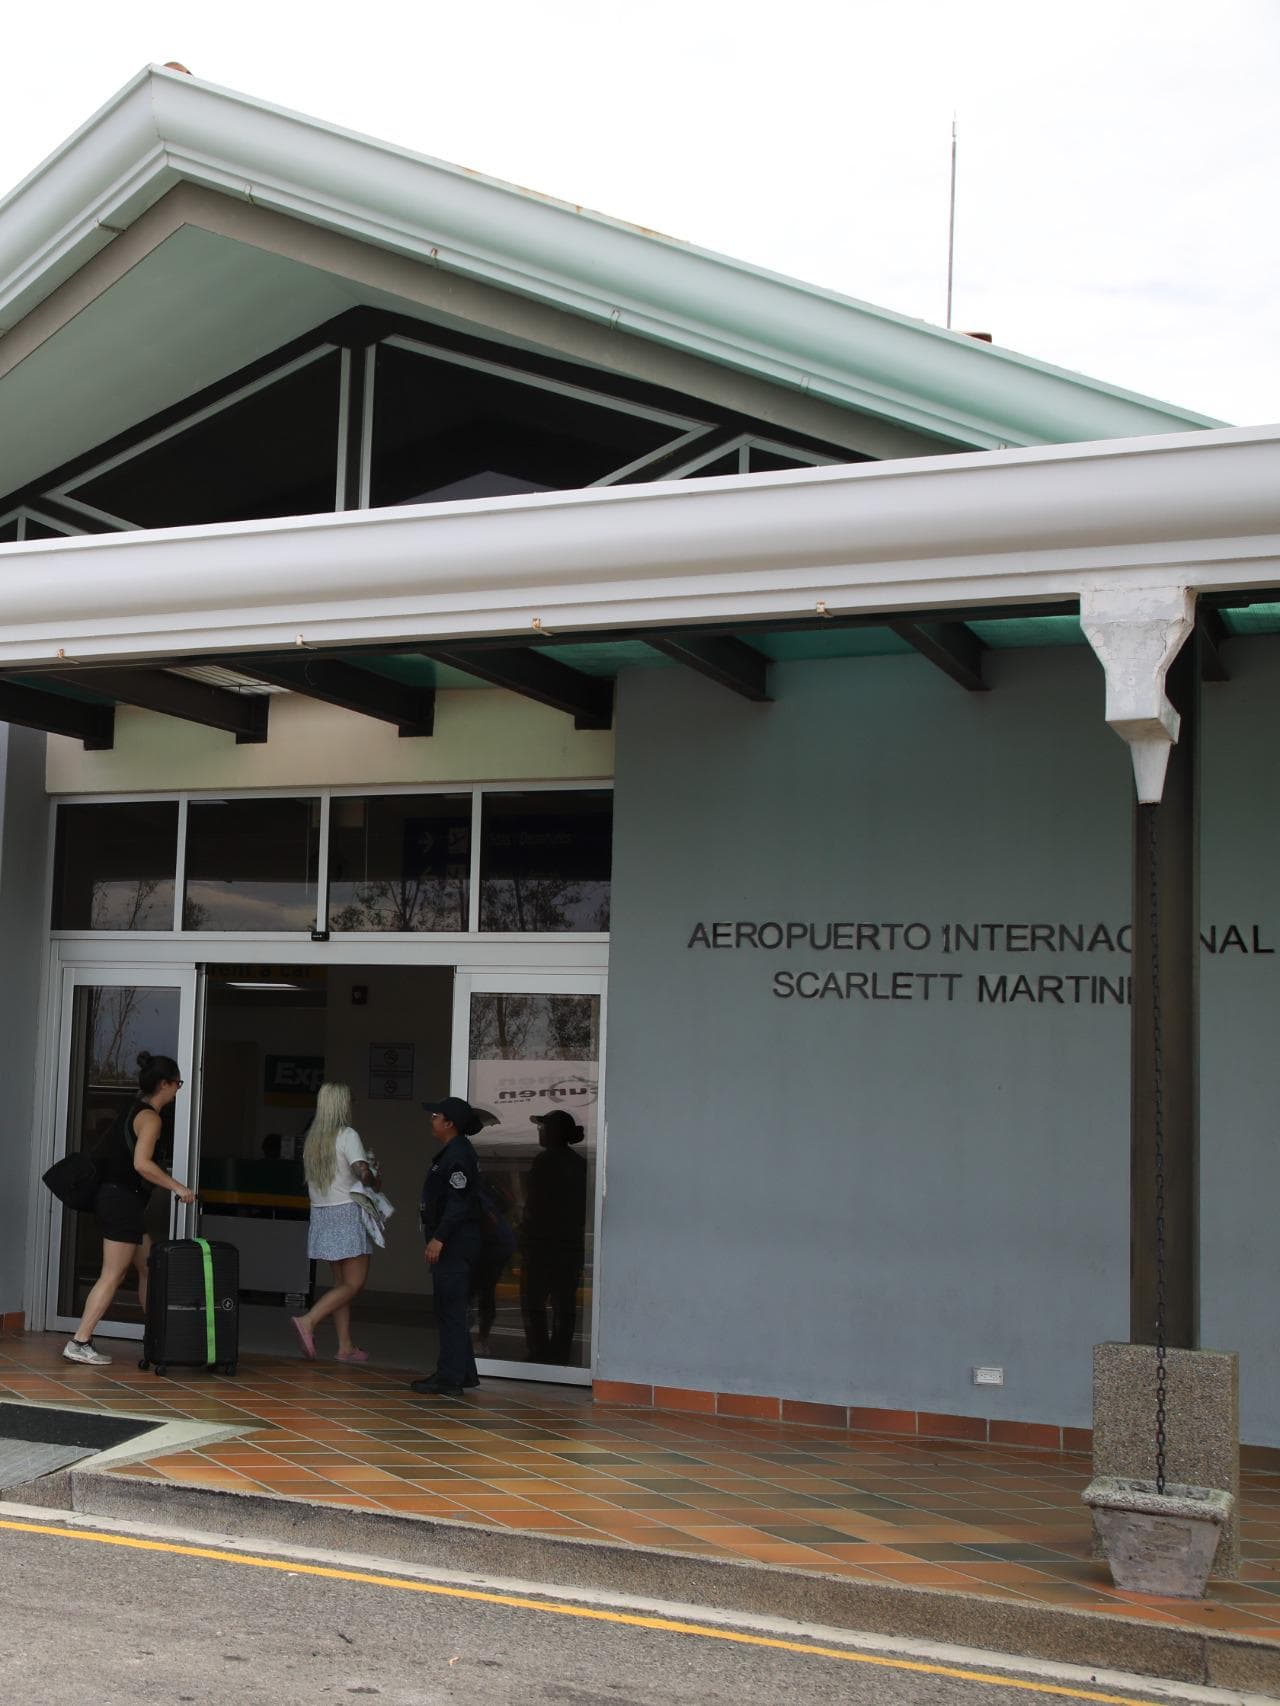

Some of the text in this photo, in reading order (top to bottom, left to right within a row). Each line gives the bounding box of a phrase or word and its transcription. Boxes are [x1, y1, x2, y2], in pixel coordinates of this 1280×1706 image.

[687, 921, 1276, 954] AEROPUERTO INTERNACNAL
[772, 970, 1133, 1005] SCARLETT MARTIN
